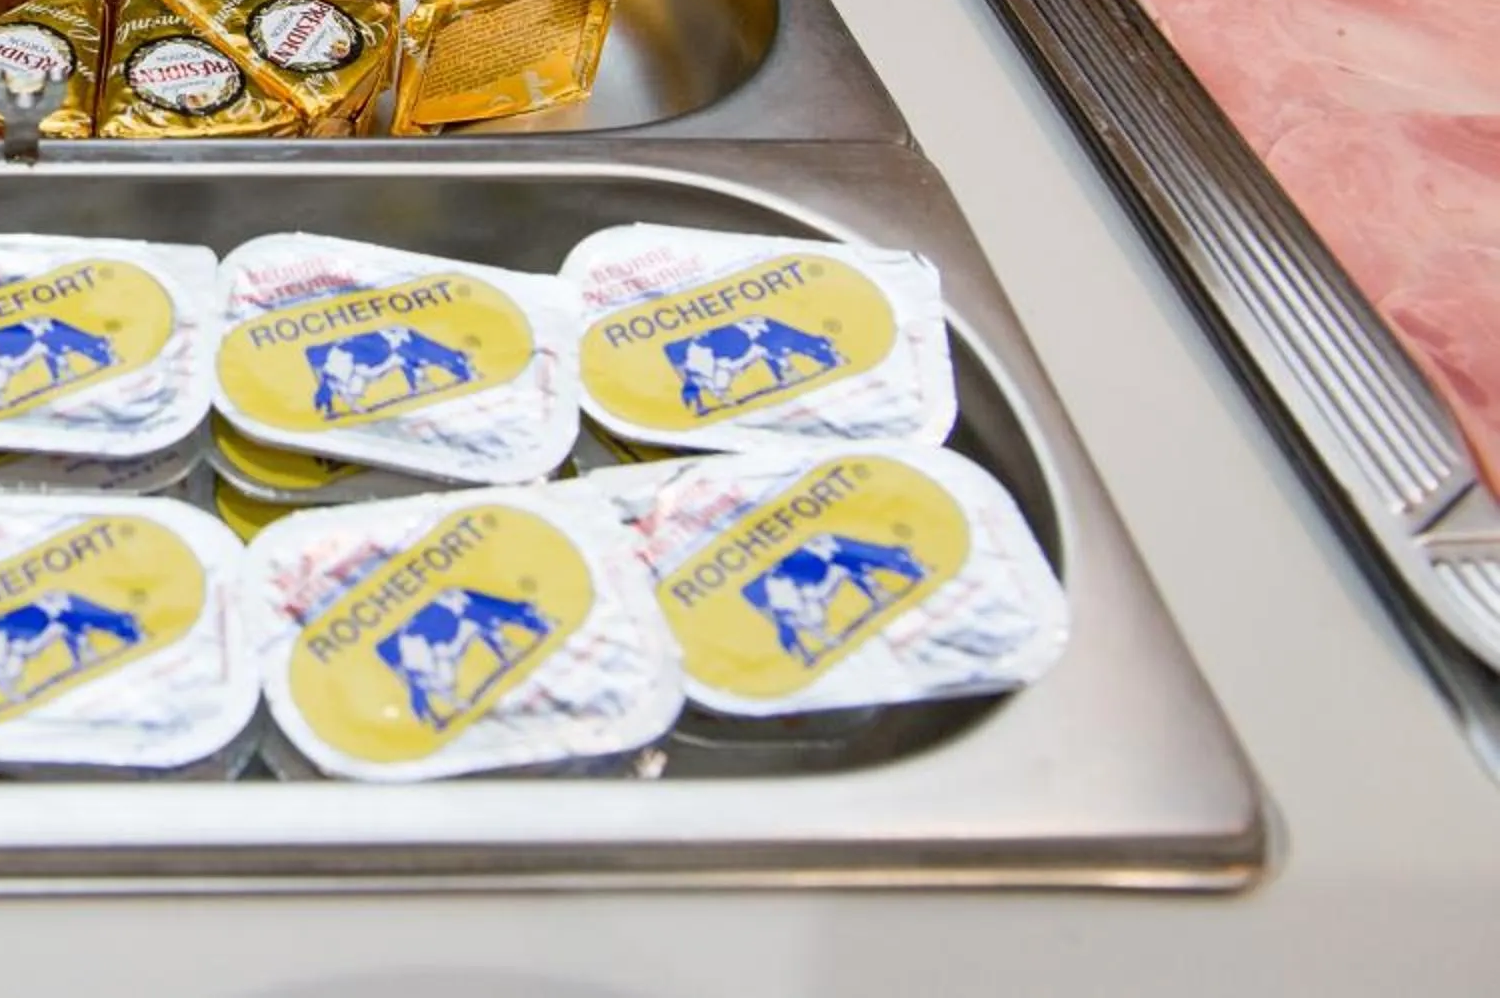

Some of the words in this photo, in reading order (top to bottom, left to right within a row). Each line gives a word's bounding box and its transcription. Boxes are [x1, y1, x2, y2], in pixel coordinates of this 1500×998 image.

[249, 279, 455, 349] ROCHEFORT
[604, 260, 807, 349] ROCHEFORT
[306, 514, 487, 664] ROCHEFORT
[671, 463, 858, 608] ROCHEFORT
